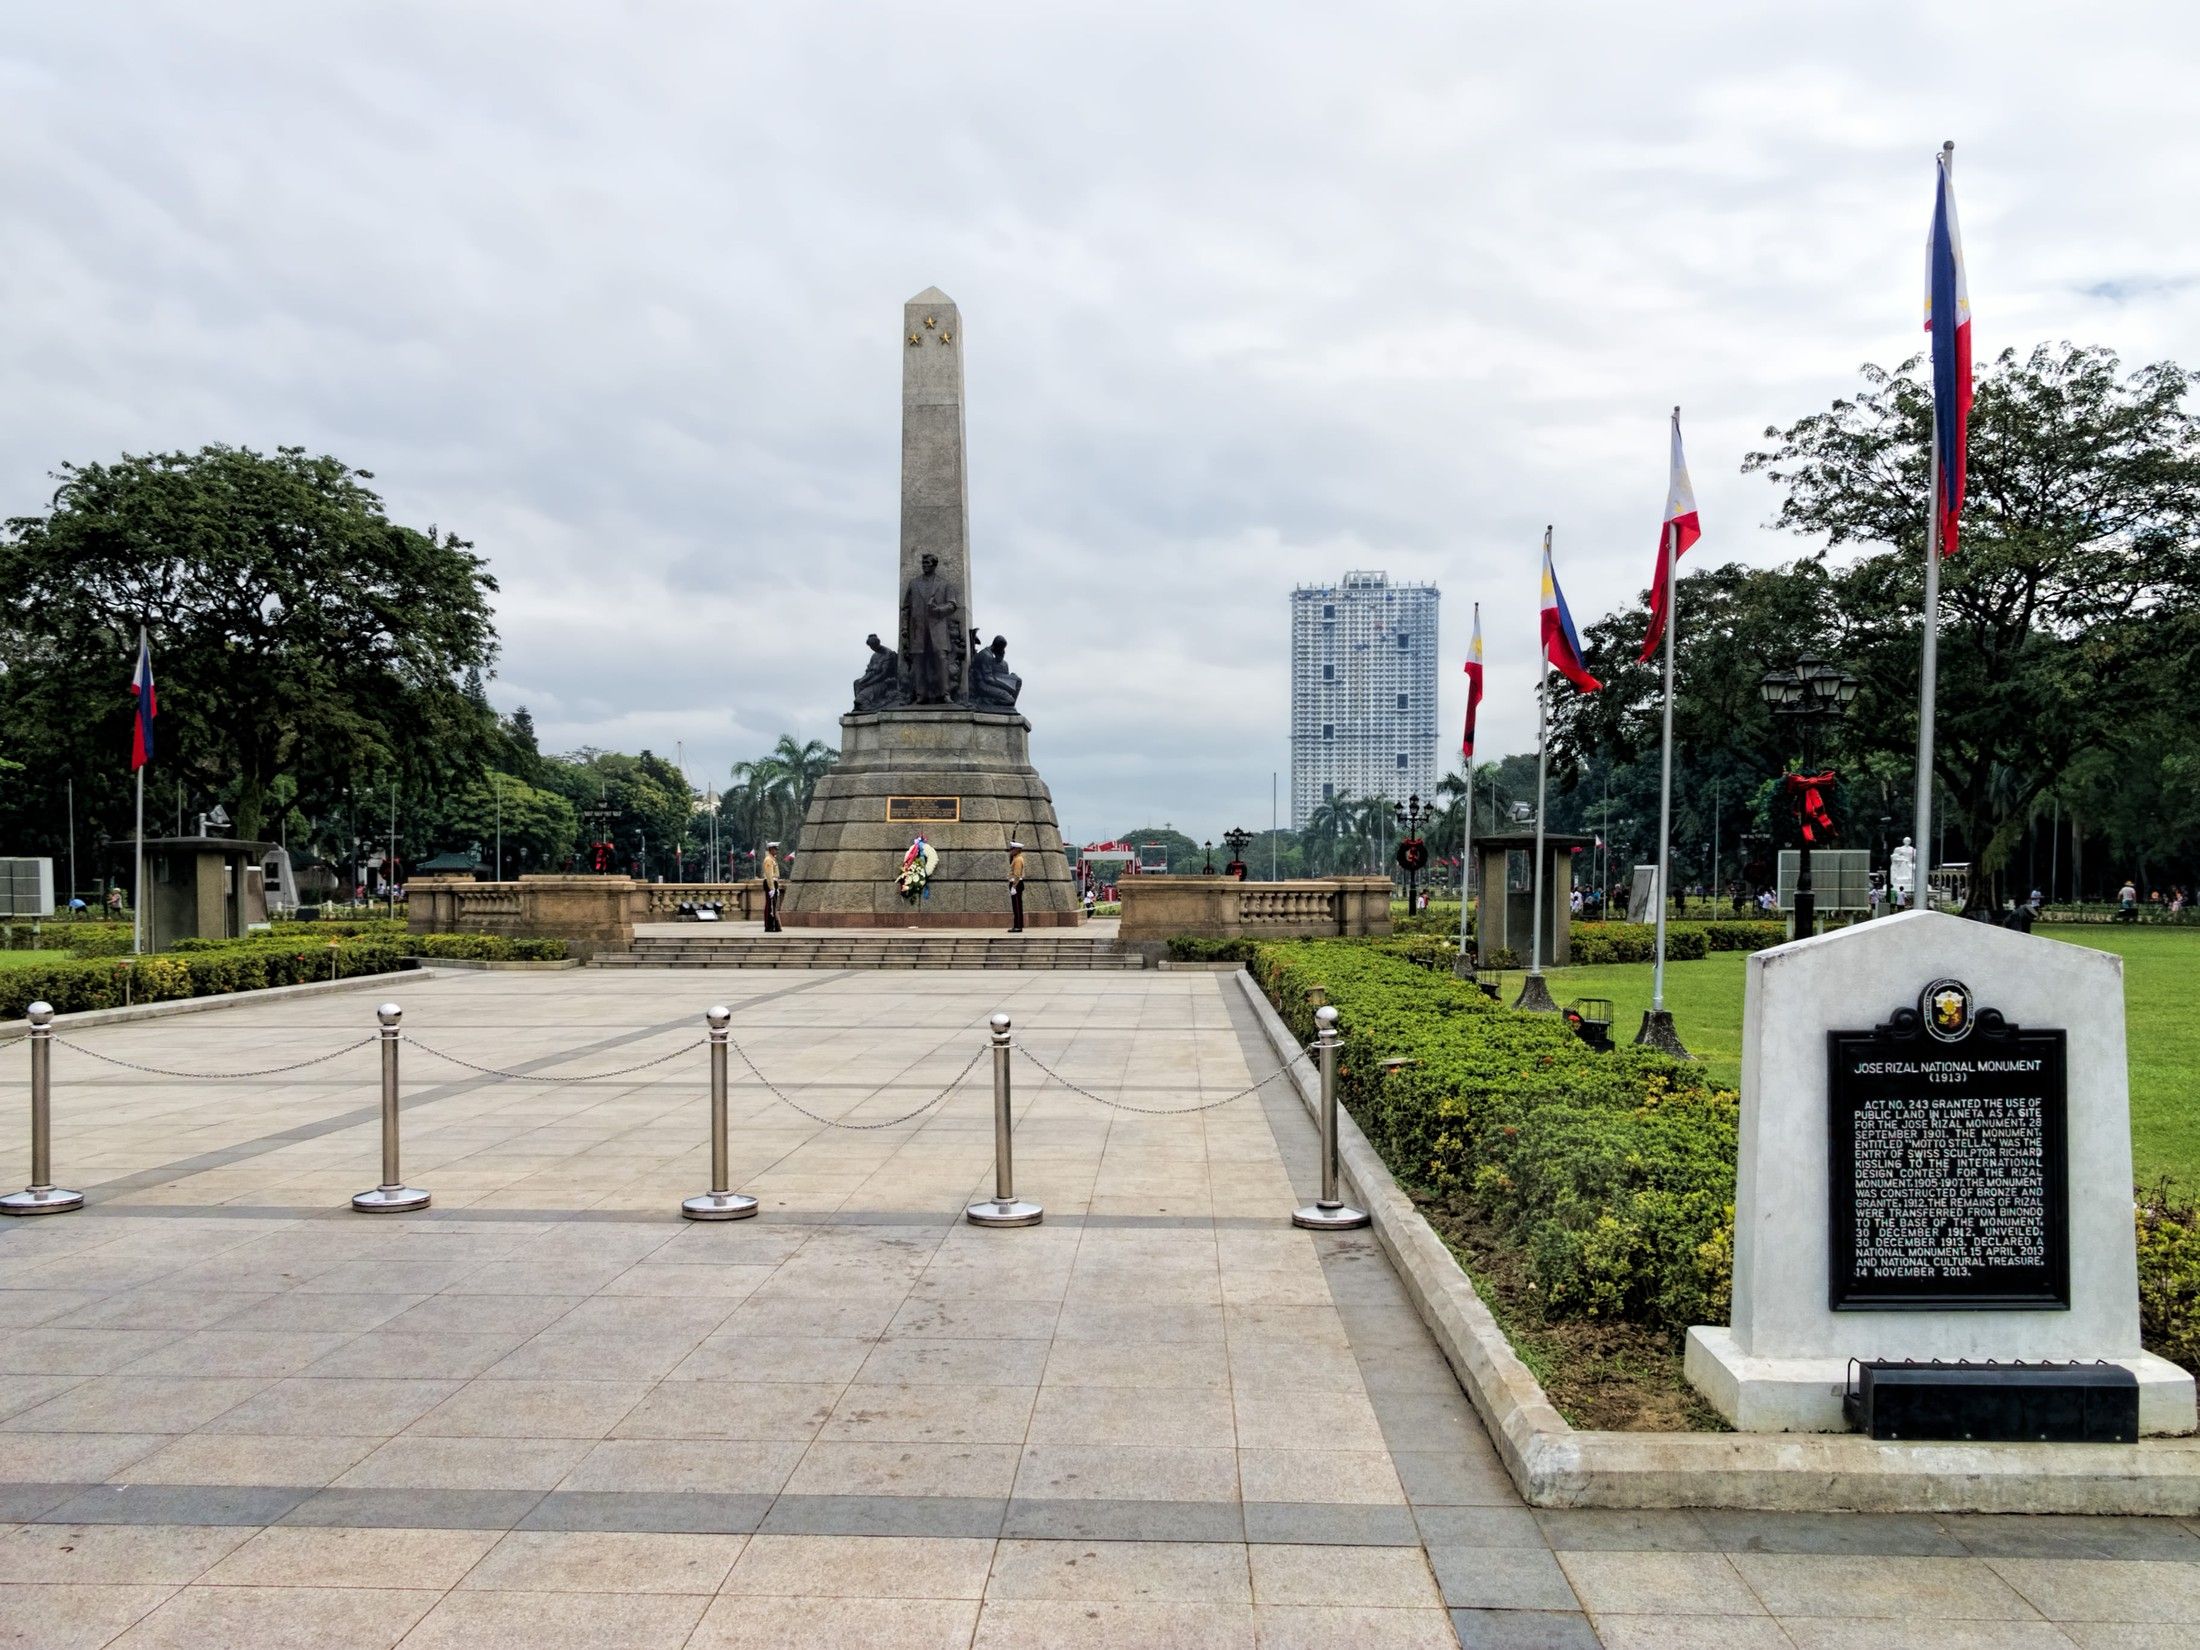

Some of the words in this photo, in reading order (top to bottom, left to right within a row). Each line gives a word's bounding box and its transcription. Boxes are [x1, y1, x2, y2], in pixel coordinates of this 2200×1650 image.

[1854, 1063, 1883, 1073] JOSE
[1886, 1062, 1919, 1073] RIZAL
[1921, 1061, 1976, 1073] NATIONAL
[1978, 1061, 2042, 1072] MONUMENT
[1929, 1073, 1967, 1082] (1913)
[1865, 1100, 1885, 1109] ACT
[1889, 1100, 1905, 1109] NO.
[1909, 1100, 1928, 1109] 243
[1932, 1099, 1980, 1108] GRANTED
[1983, 1099, 2003, 1108] THE
[2006, 1098, 2025, 1108] USE
[2028, 1098, 2042, 1107] OF
[1855, 1110, 1891, 1119] PUBLIC
[1896, 1110, 1925, 1119] LAND
[1930, 1110, 1939, 1118] IN
[1944, 1109, 1984, 1118] LUNETA
[1989, 1109, 2003, 1118] AS
[2007, 1109, 2014, 1118] A
[2018, 1108, 2042, 1117] SITE
[1855, 1120, 1875, 1129] FOR
[1878, 1120, 1897, 1129] THE
[1902, 1120, 1928, 1129] JOSE
[1931, 1119, 1962, 1128] RIZAL
[2029, 1119, 2041, 1127] 28
[1855, 1130, 1917, 1139] SEPTEMBER
[1923, 1129, 1949, 1138] 1901.
[1956, 1129, 1976, 1138] THE
[1855, 1139, 1902, 1148] ENTITLED
[1999, 1138, 2020, 1147] WAS
[2023, 1138, 2042, 1147] THE
[1855, 1149, 1887, 1158] ENTRY
[1891, 1149, 1903, 1158] OF
[1907, 1149, 1940, 1158] SWISS
[1944, 1148, 1996, 1157] SCULPTOR
[2000, 1148, 2043, 1157] RICHARD
[1856, 1160, 1902, 1168] KISSLING
[1910, 1159, 1923, 1168] TO
[1929, 1159, 1949, 1168] THE
[1957, 1158, 2042, 1168] INTERNATIONAL
[1856, 1169, 1893, 1178] DESIGN
[1900, 1169, 1948, 1178] CONTEST
[1957, 1168, 1977, 1177] FOR
[1984, 1168, 2004, 1177] THE
[2011, 1168, 2043, 1177] RIZAL
[1966, 1178, 1984, 1187] THE
[1987, 1178, 2042, 1187] MONUMENT
[1856, 1189, 1877, 1198] WAS
[1880, 1188, 1956, 1197] CONSTRUCTED
[1960, 1188, 1973, 1197] OF
[1977, 1188, 2017, 1197] BRONZE
[2022, 1188, 2043, 1197] AND
[1904, 1198, 1927, 1207] 1912.
[1928, 1198, 1947, 1207] THE
[1950, 1198, 1995, 1207] REMAINS
[1998, 1198, 2011, 1207] OF
[2014, 1198, 2043, 1206] RIZAL
[1856, 1208, 1884, 1217] WERE
[1889, 1208, 1963, 1217] TRANSFERRED
[1968, 1208, 1996, 1217] FROM
[2000, 1208, 2043, 1216] BINONDO
[1856, 1218, 1870, 1227] TO
[1874, 1218, 1895, 1227] THE
[1900, 1218, 1927, 1227] BASE
[1933, 1218, 1946, 1227] OF
[1953, 1218, 1974, 1227] THE
[1856, 1228, 1869, 1237] 30
[1879, 1228, 1939, 1237] DECEMBER
[1948, 1227, 1975, 1237] 1912.
[1856, 1238, 1869, 1247] 30
[1876, 1238, 1935, 1247] DECEMBER
[1941, 1237, 1967, 1246] 1913.
[1974, 1237, 2031, 1246] DECLARED
[2036, 1237, 2044, 1246] A
[1856, 1248, 1905, 1257] NATIONAL
[1970, 1247, 1982, 1256] 15
[1986, 1247, 2016, 1256] APRIL
[2020, 1247, 2044, 1256] 2013
[1856, 1257, 1877, 1266] AND
[1881, 1257, 1930, 1266] NATIONAL
[1933, 1257, 1985, 1266] CULTURAL
[1856, 1267, 1867, 1277] 14
[1874, 1267, 1935, 1277] NOVEMBER
[1943, 1267, 1971, 1276] 2013.
